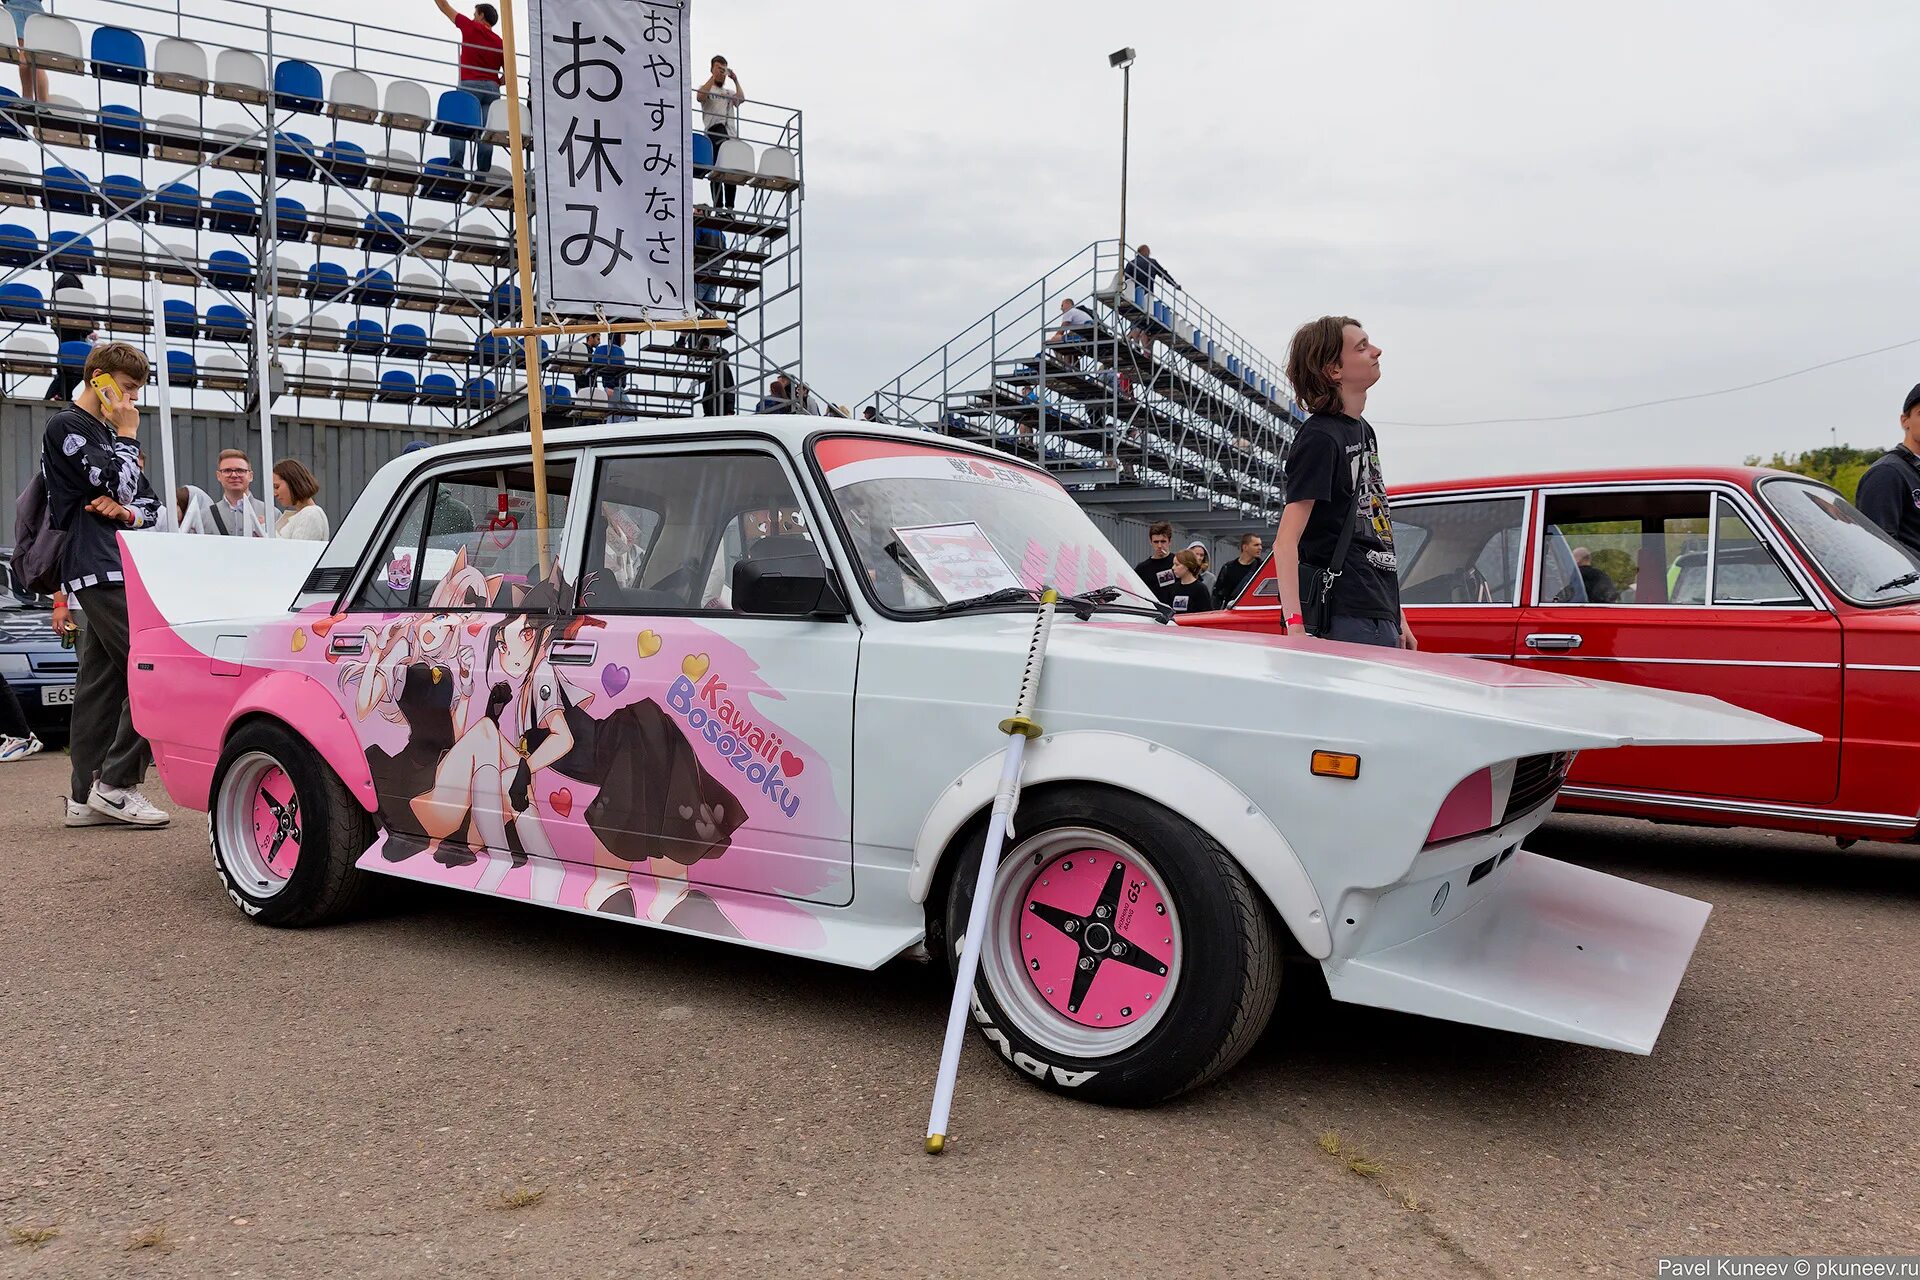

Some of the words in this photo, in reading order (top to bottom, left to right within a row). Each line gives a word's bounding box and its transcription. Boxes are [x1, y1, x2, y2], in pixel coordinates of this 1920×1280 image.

[551, 20, 633, 278] お休み
[642, 9, 677, 305] おやすみなさい
[665, 674, 801, 819] Bosozoku
[700, 673, 783, 763] Kawaii
[1127, 879, 1141, 904] G5
